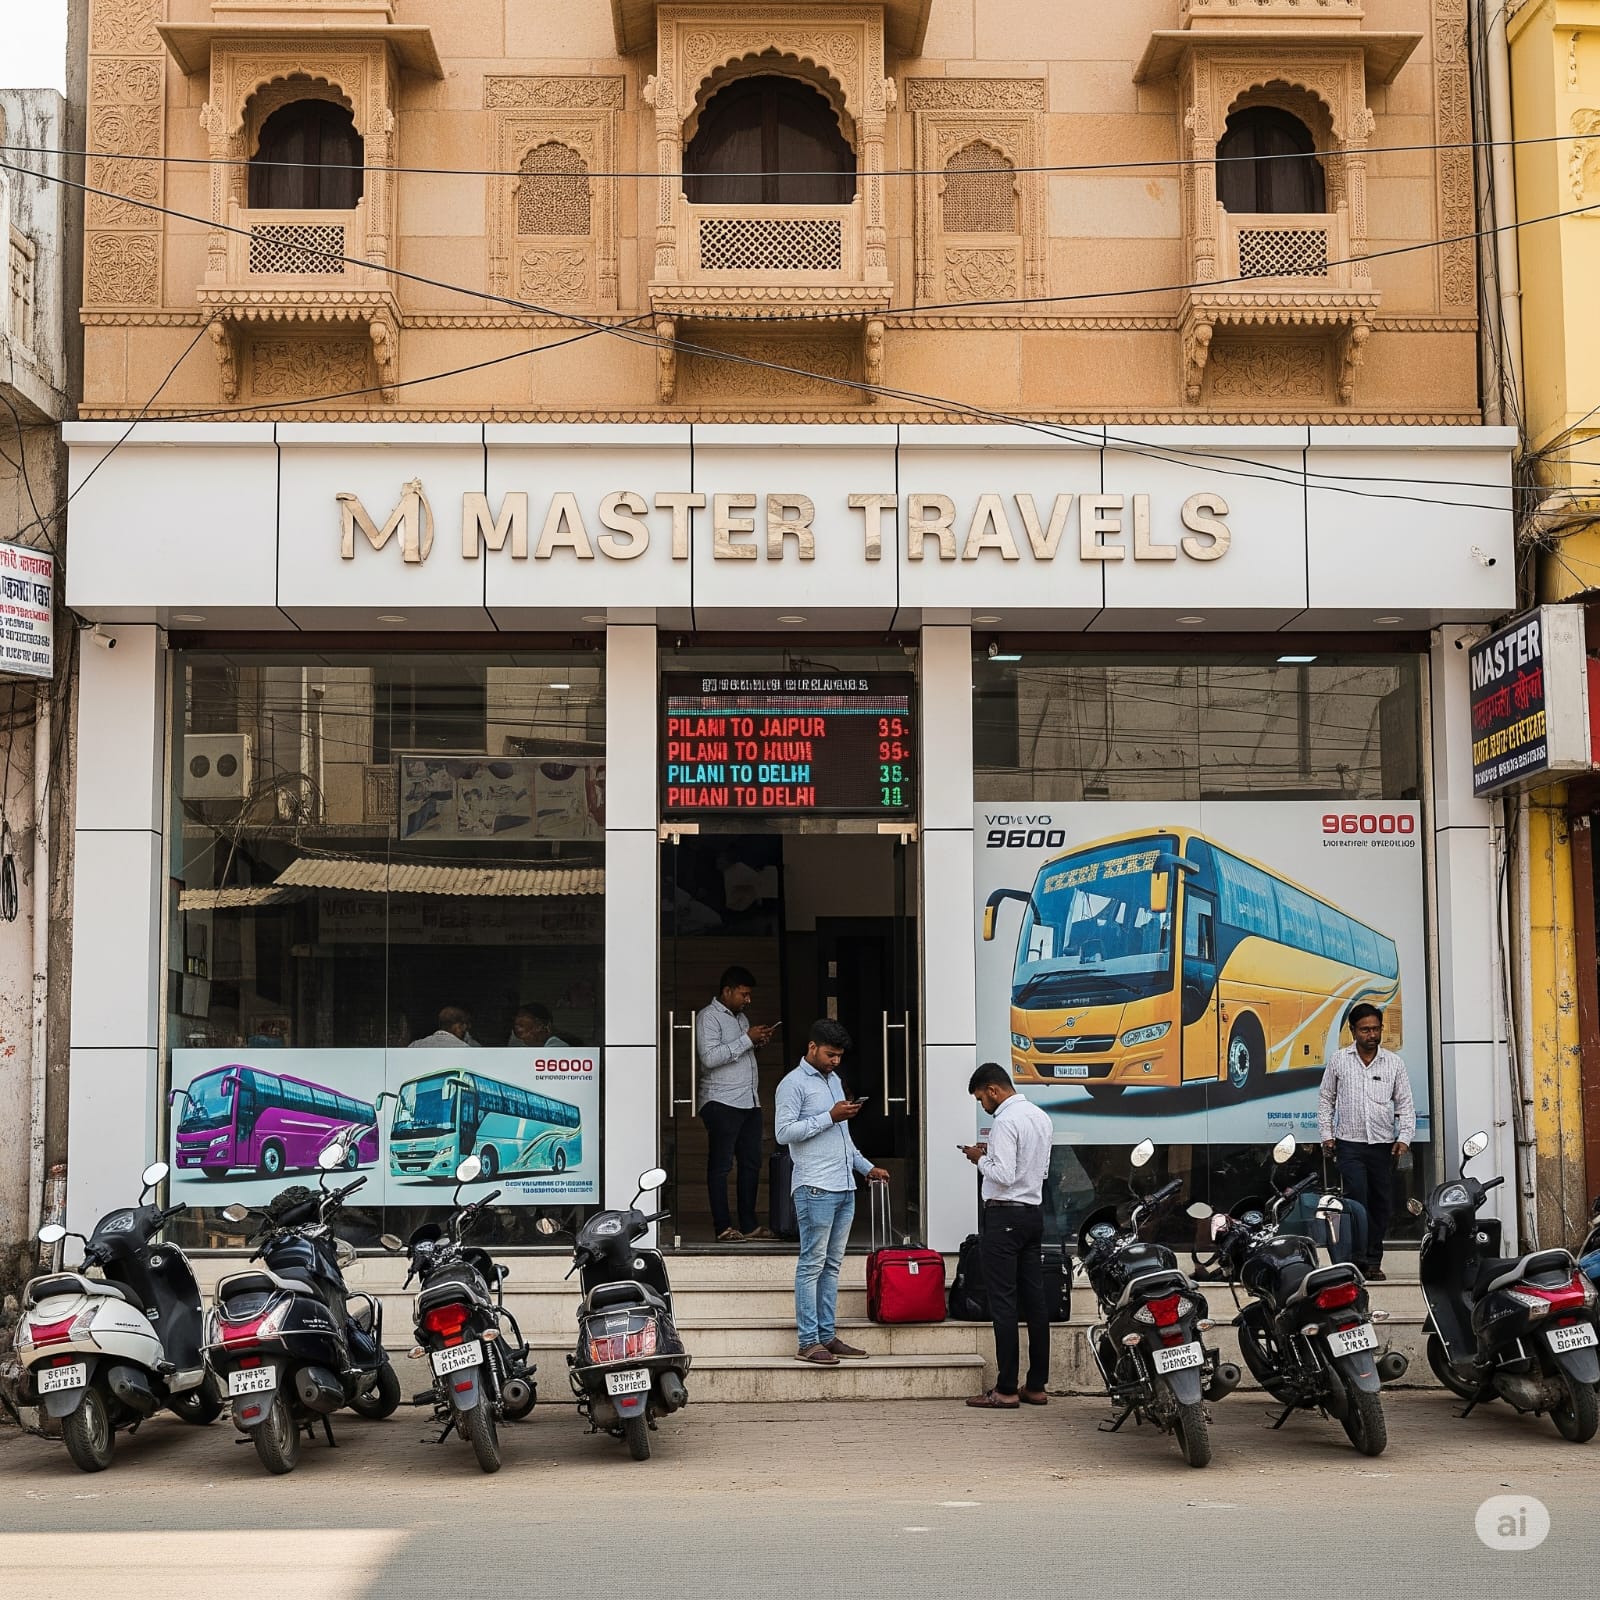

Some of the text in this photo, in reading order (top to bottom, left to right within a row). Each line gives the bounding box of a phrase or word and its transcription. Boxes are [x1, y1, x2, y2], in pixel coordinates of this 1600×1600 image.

[461, 491, 816, 561] MASTER
[848, 492, 1232, 562] TRAVELS
[1471, 620, 1541, 692] MASTER
[731, 717, 754, 737] TO
[760, 717, 826, 737] JAIPUR
[735, 741, 758, 761] TO
[668, 764, 725, 783] PILANI
[730, 764, 752, 783] TO
[734, 787, 757, 807] TO
[1322, 814, 1415, 834] 96000
[986, 829, 1066, 849] 9600
[535, 1059, 593, 1072] 96000
